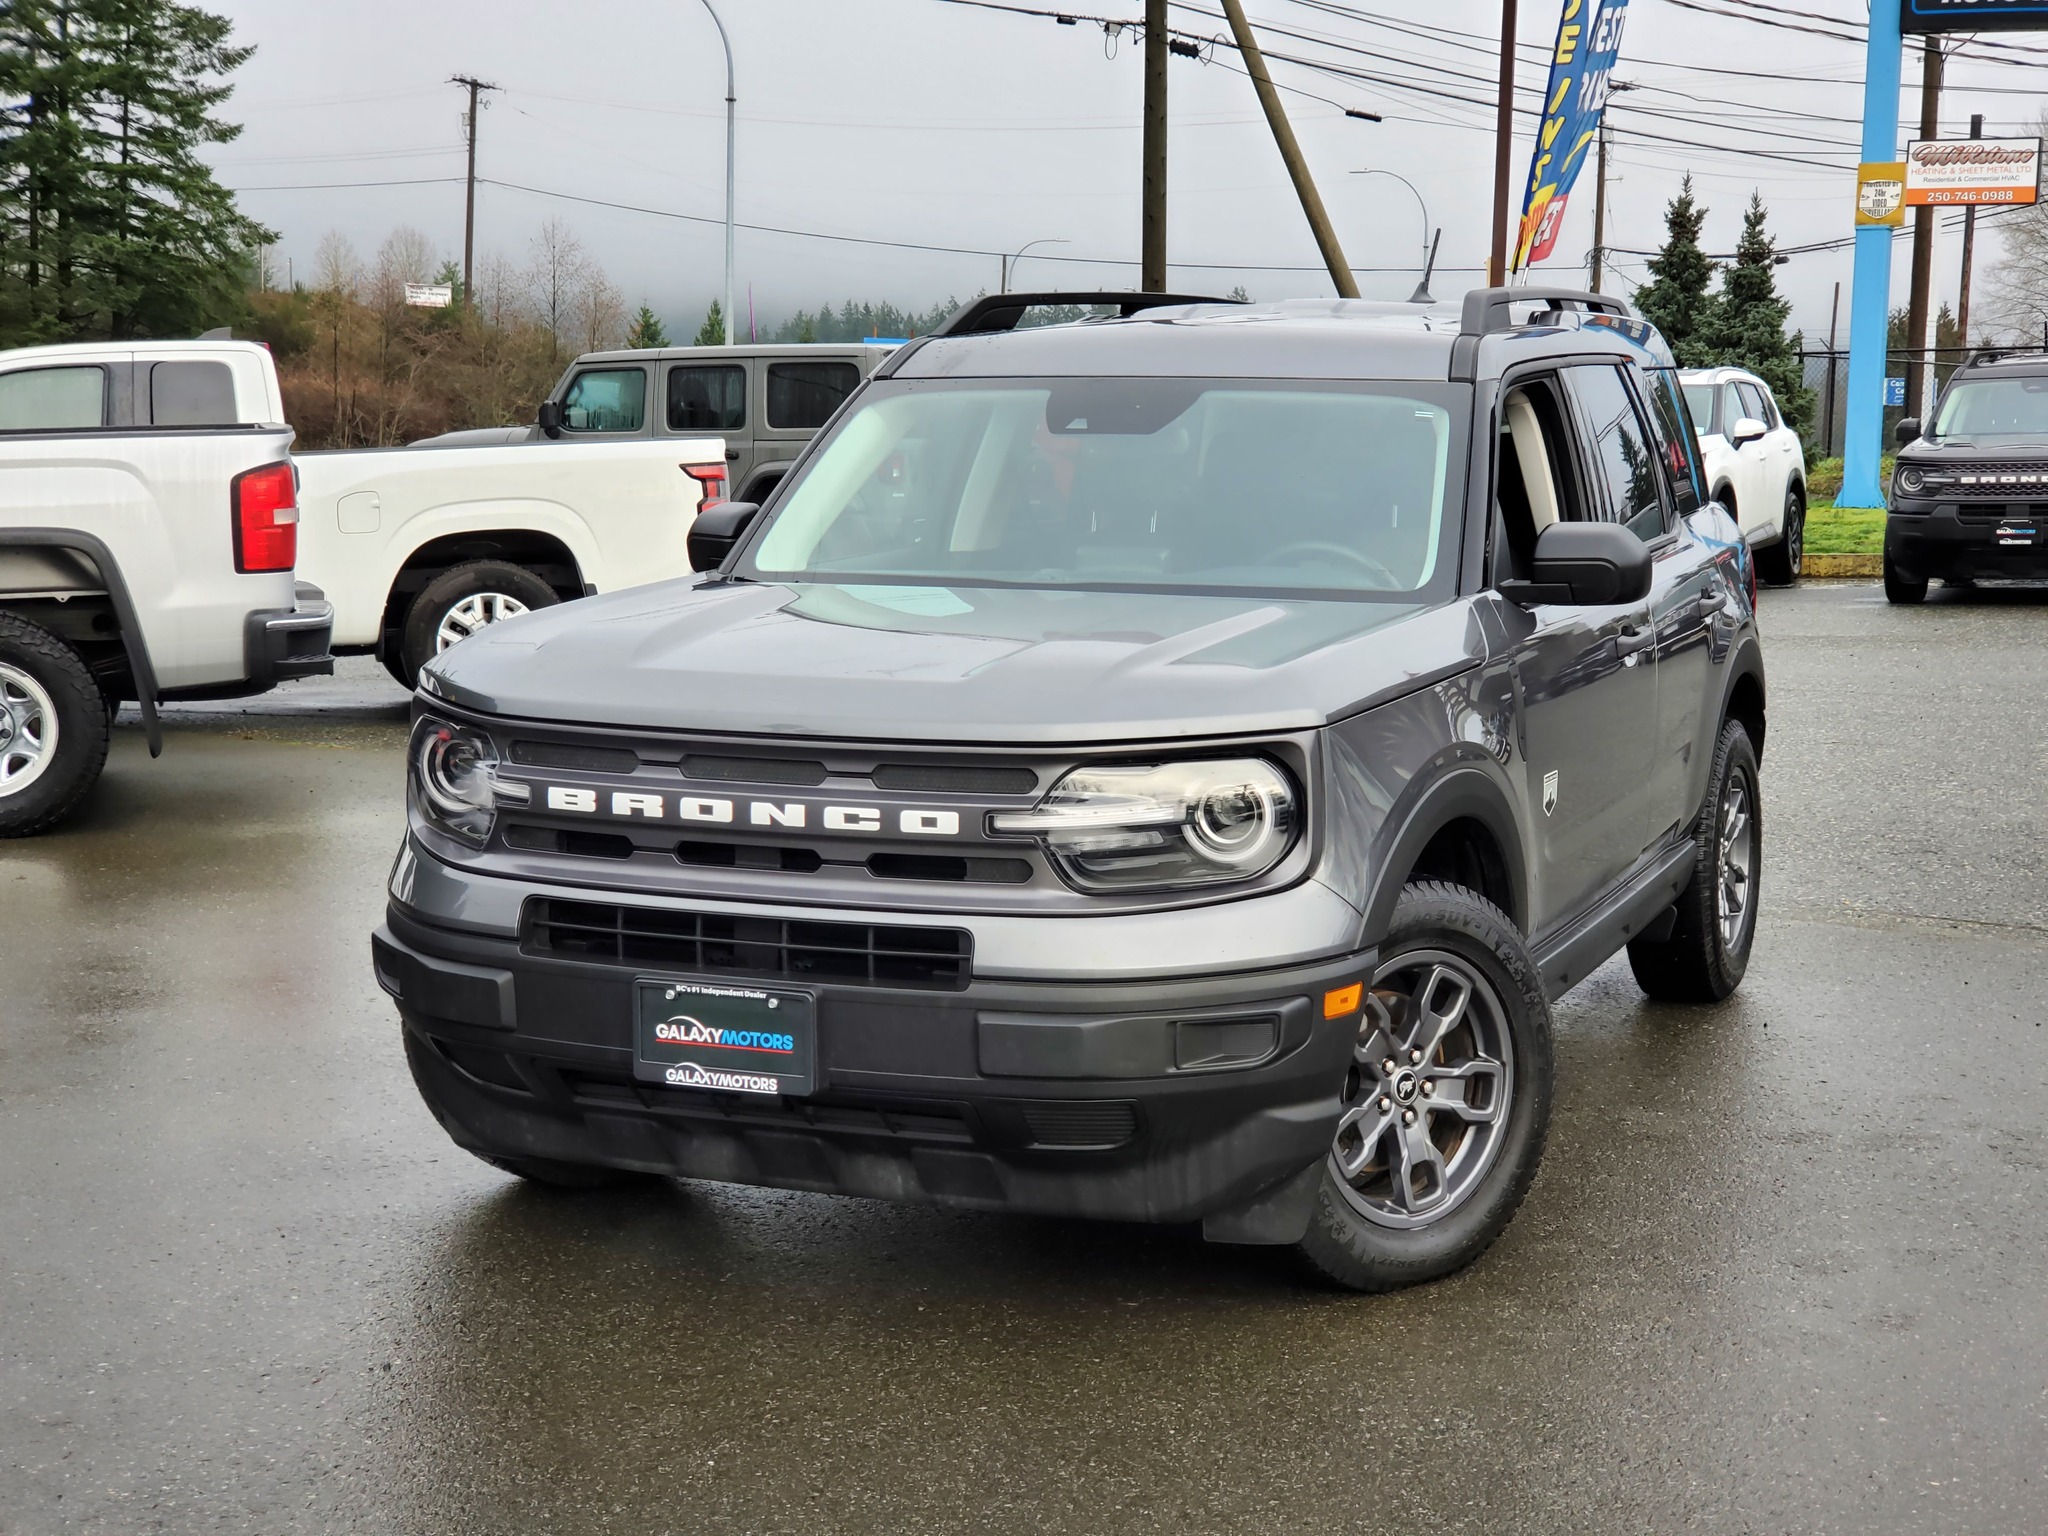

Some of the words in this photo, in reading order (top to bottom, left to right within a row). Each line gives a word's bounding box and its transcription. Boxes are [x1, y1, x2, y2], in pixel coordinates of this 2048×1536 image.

[1589, 6, 1628, 53] EST
[1911, 143, 2035, 167] Millstone
[1959, 166, 1985, 174] SHEET
[1872, 199, 1888, 207] VIDEO
[1927, 190, 2014, 202] 250-746-0988
[547, 786, 960, 835] BRONCO
[675, 984, 691, 993] BC's
[701, 987, 744, 997] Independent
[744, 990, 767, 999] Dealer
